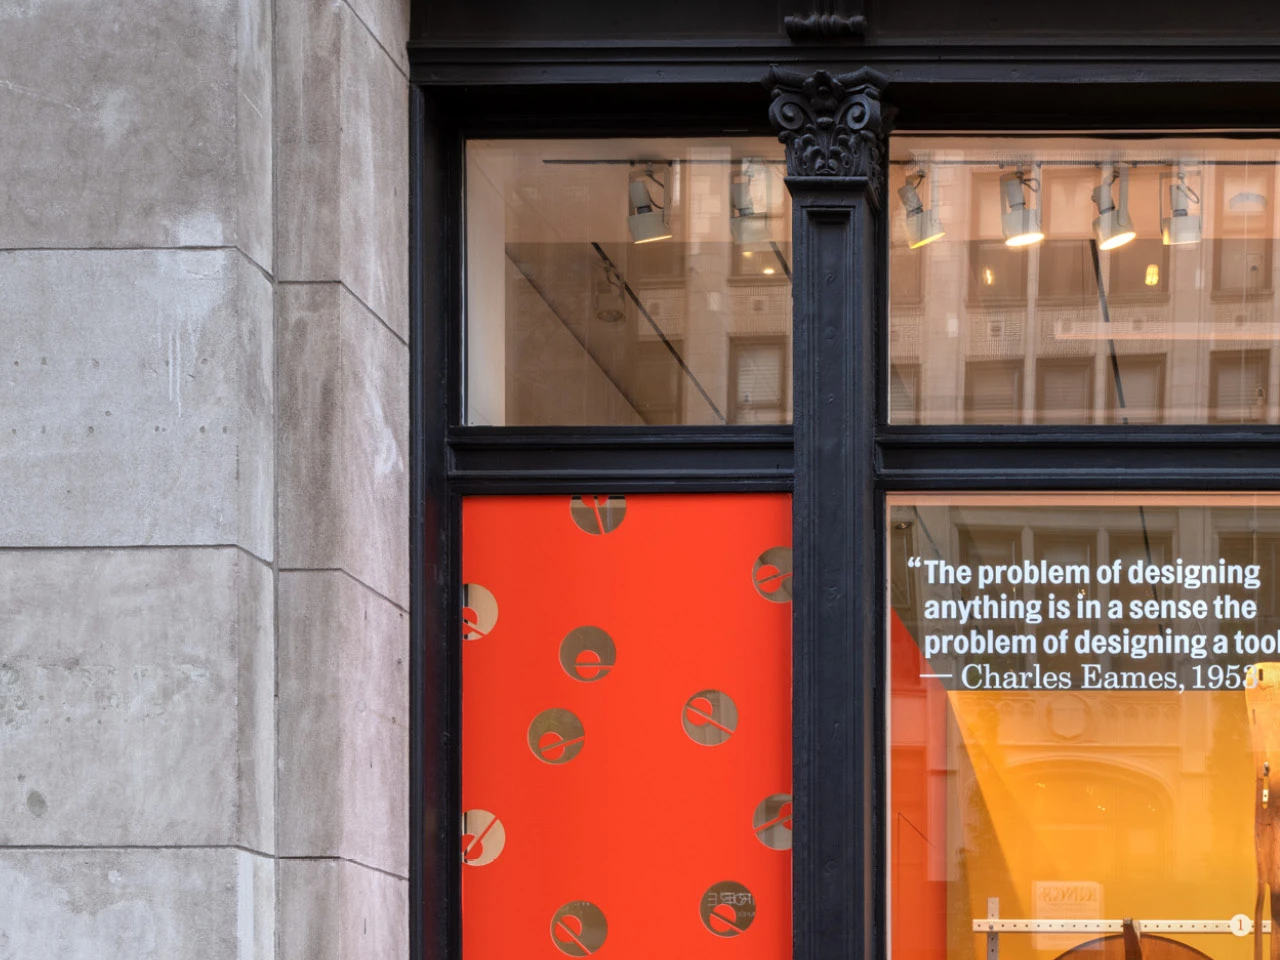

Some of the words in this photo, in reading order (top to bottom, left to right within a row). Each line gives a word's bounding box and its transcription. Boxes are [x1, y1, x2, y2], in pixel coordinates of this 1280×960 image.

[907, 556, 972, 585] “The
[978, 560, 1089, 589] problem
[1096, 559, 1122, 585] of
[1127, 558, 1261, 589] designing
[924, 594, 1042, 624] anything
[1048, 594, 1070, 619] is
[1077, 593, 1100, 619] in
[1107, 600, 1123, 619] a
[1129, 600, 1208, 620] sense
[1212, 595, 1257, 620] the
[924, 629, 1037, 659] problem
[1042, 628, 1068, 654] of
[1074, 628, 1208, 659] designing
[1212, 635, 1228, 655] a
[961, 663, 1072, 690] Charles
[1081, 663, 1185, 694] Eames,
[1192, 664, 1259, 690] 1953
